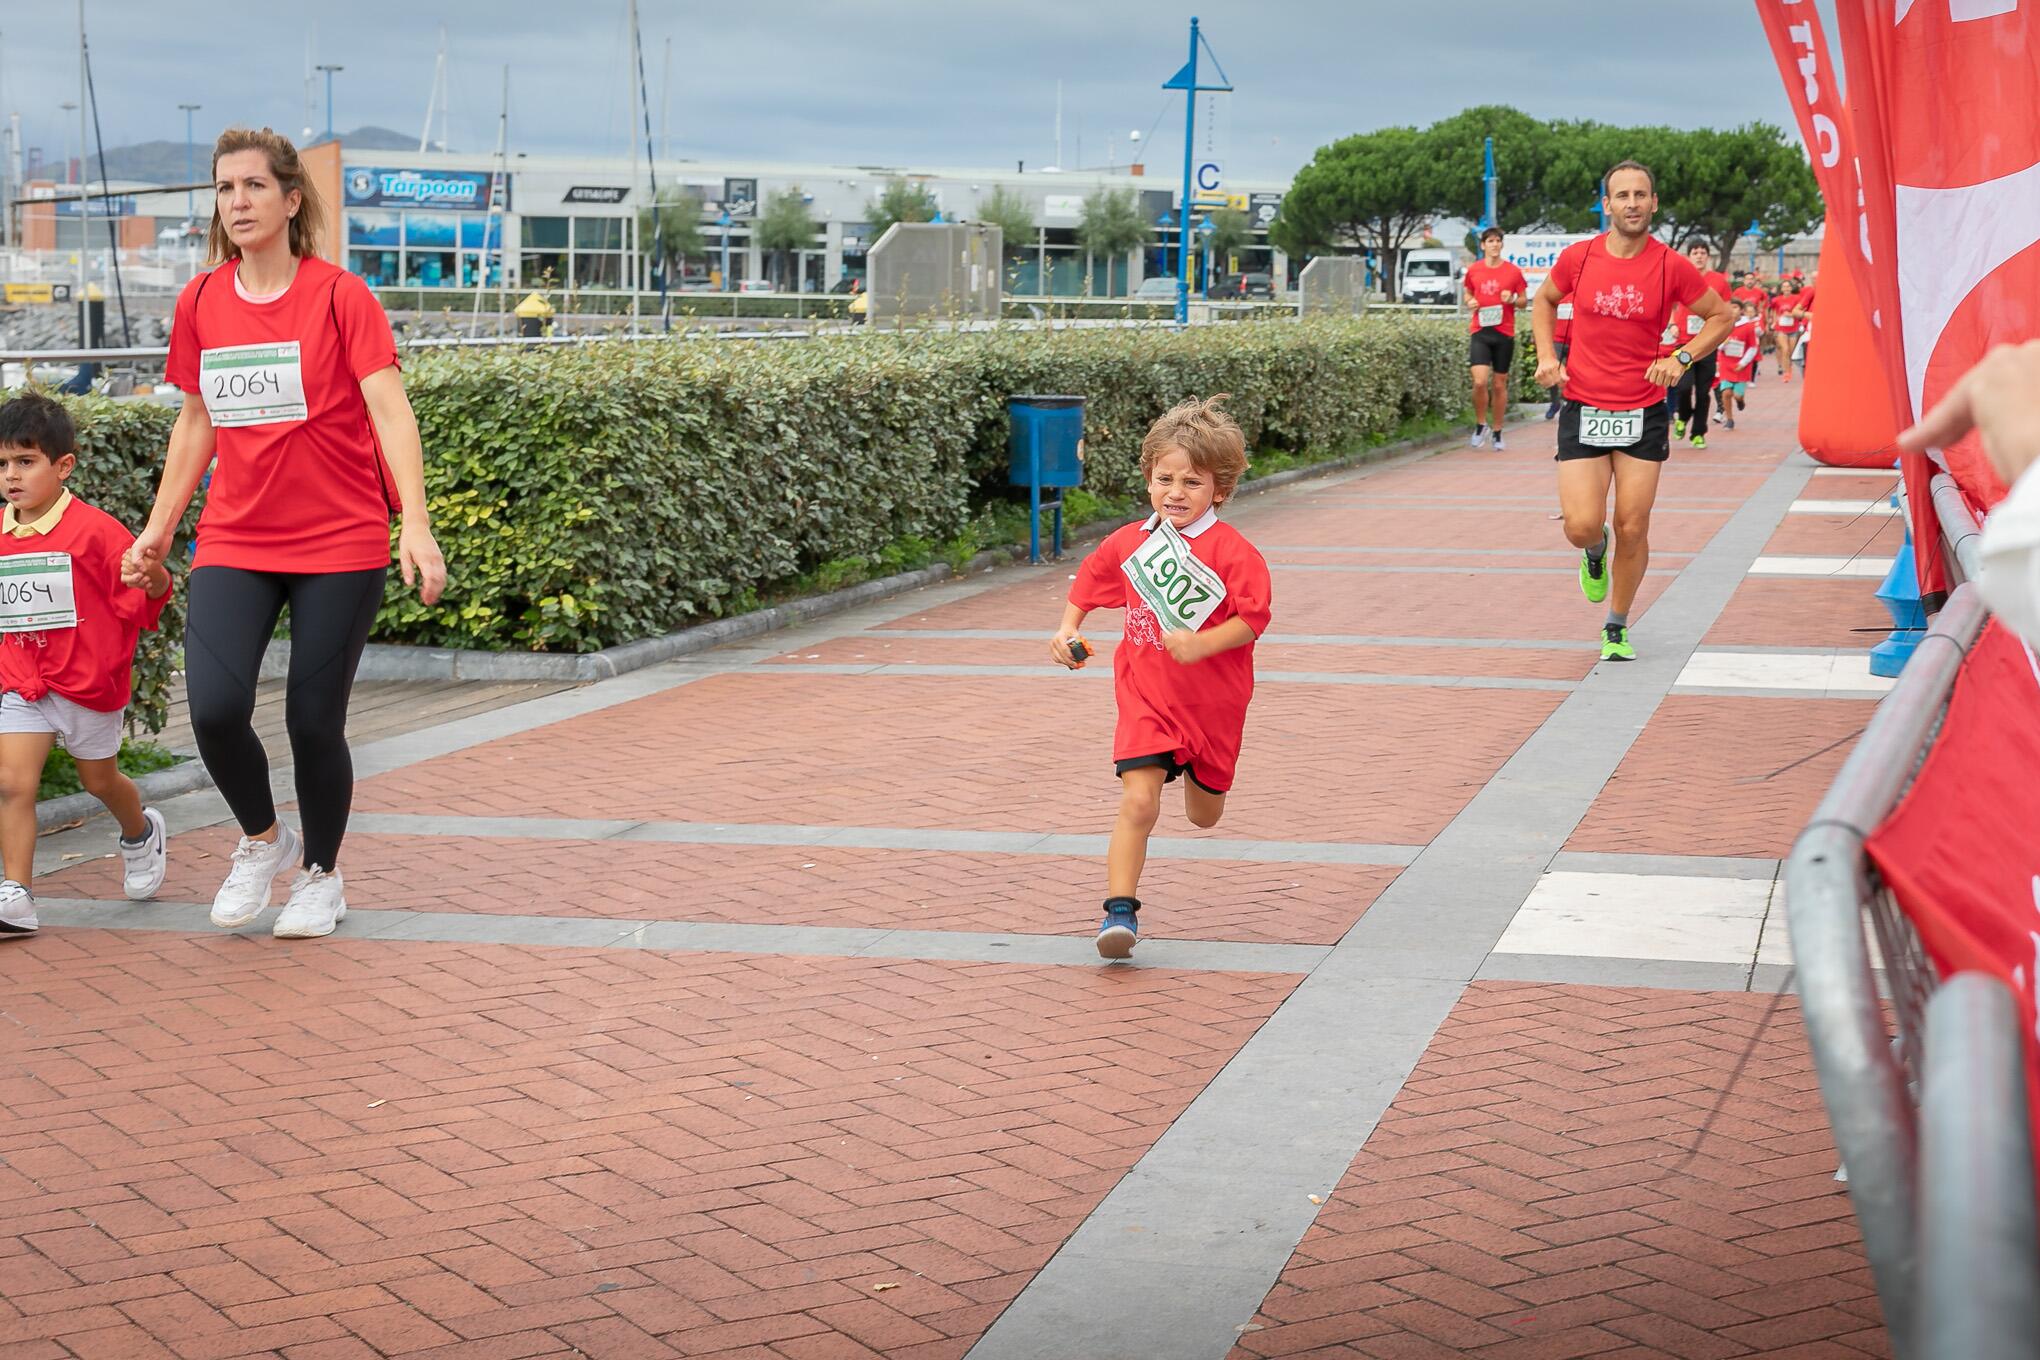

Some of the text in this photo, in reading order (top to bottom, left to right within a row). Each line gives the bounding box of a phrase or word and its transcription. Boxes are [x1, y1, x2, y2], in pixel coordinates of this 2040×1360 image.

[381, 175, 476, 200] Tarpoon
[1197, 163, 1220, 191] C
[214, 370, 280, 399] 2064
[1587, 419, 1633, 437] 2061
[1143, 543, 1211, 620] 2061
